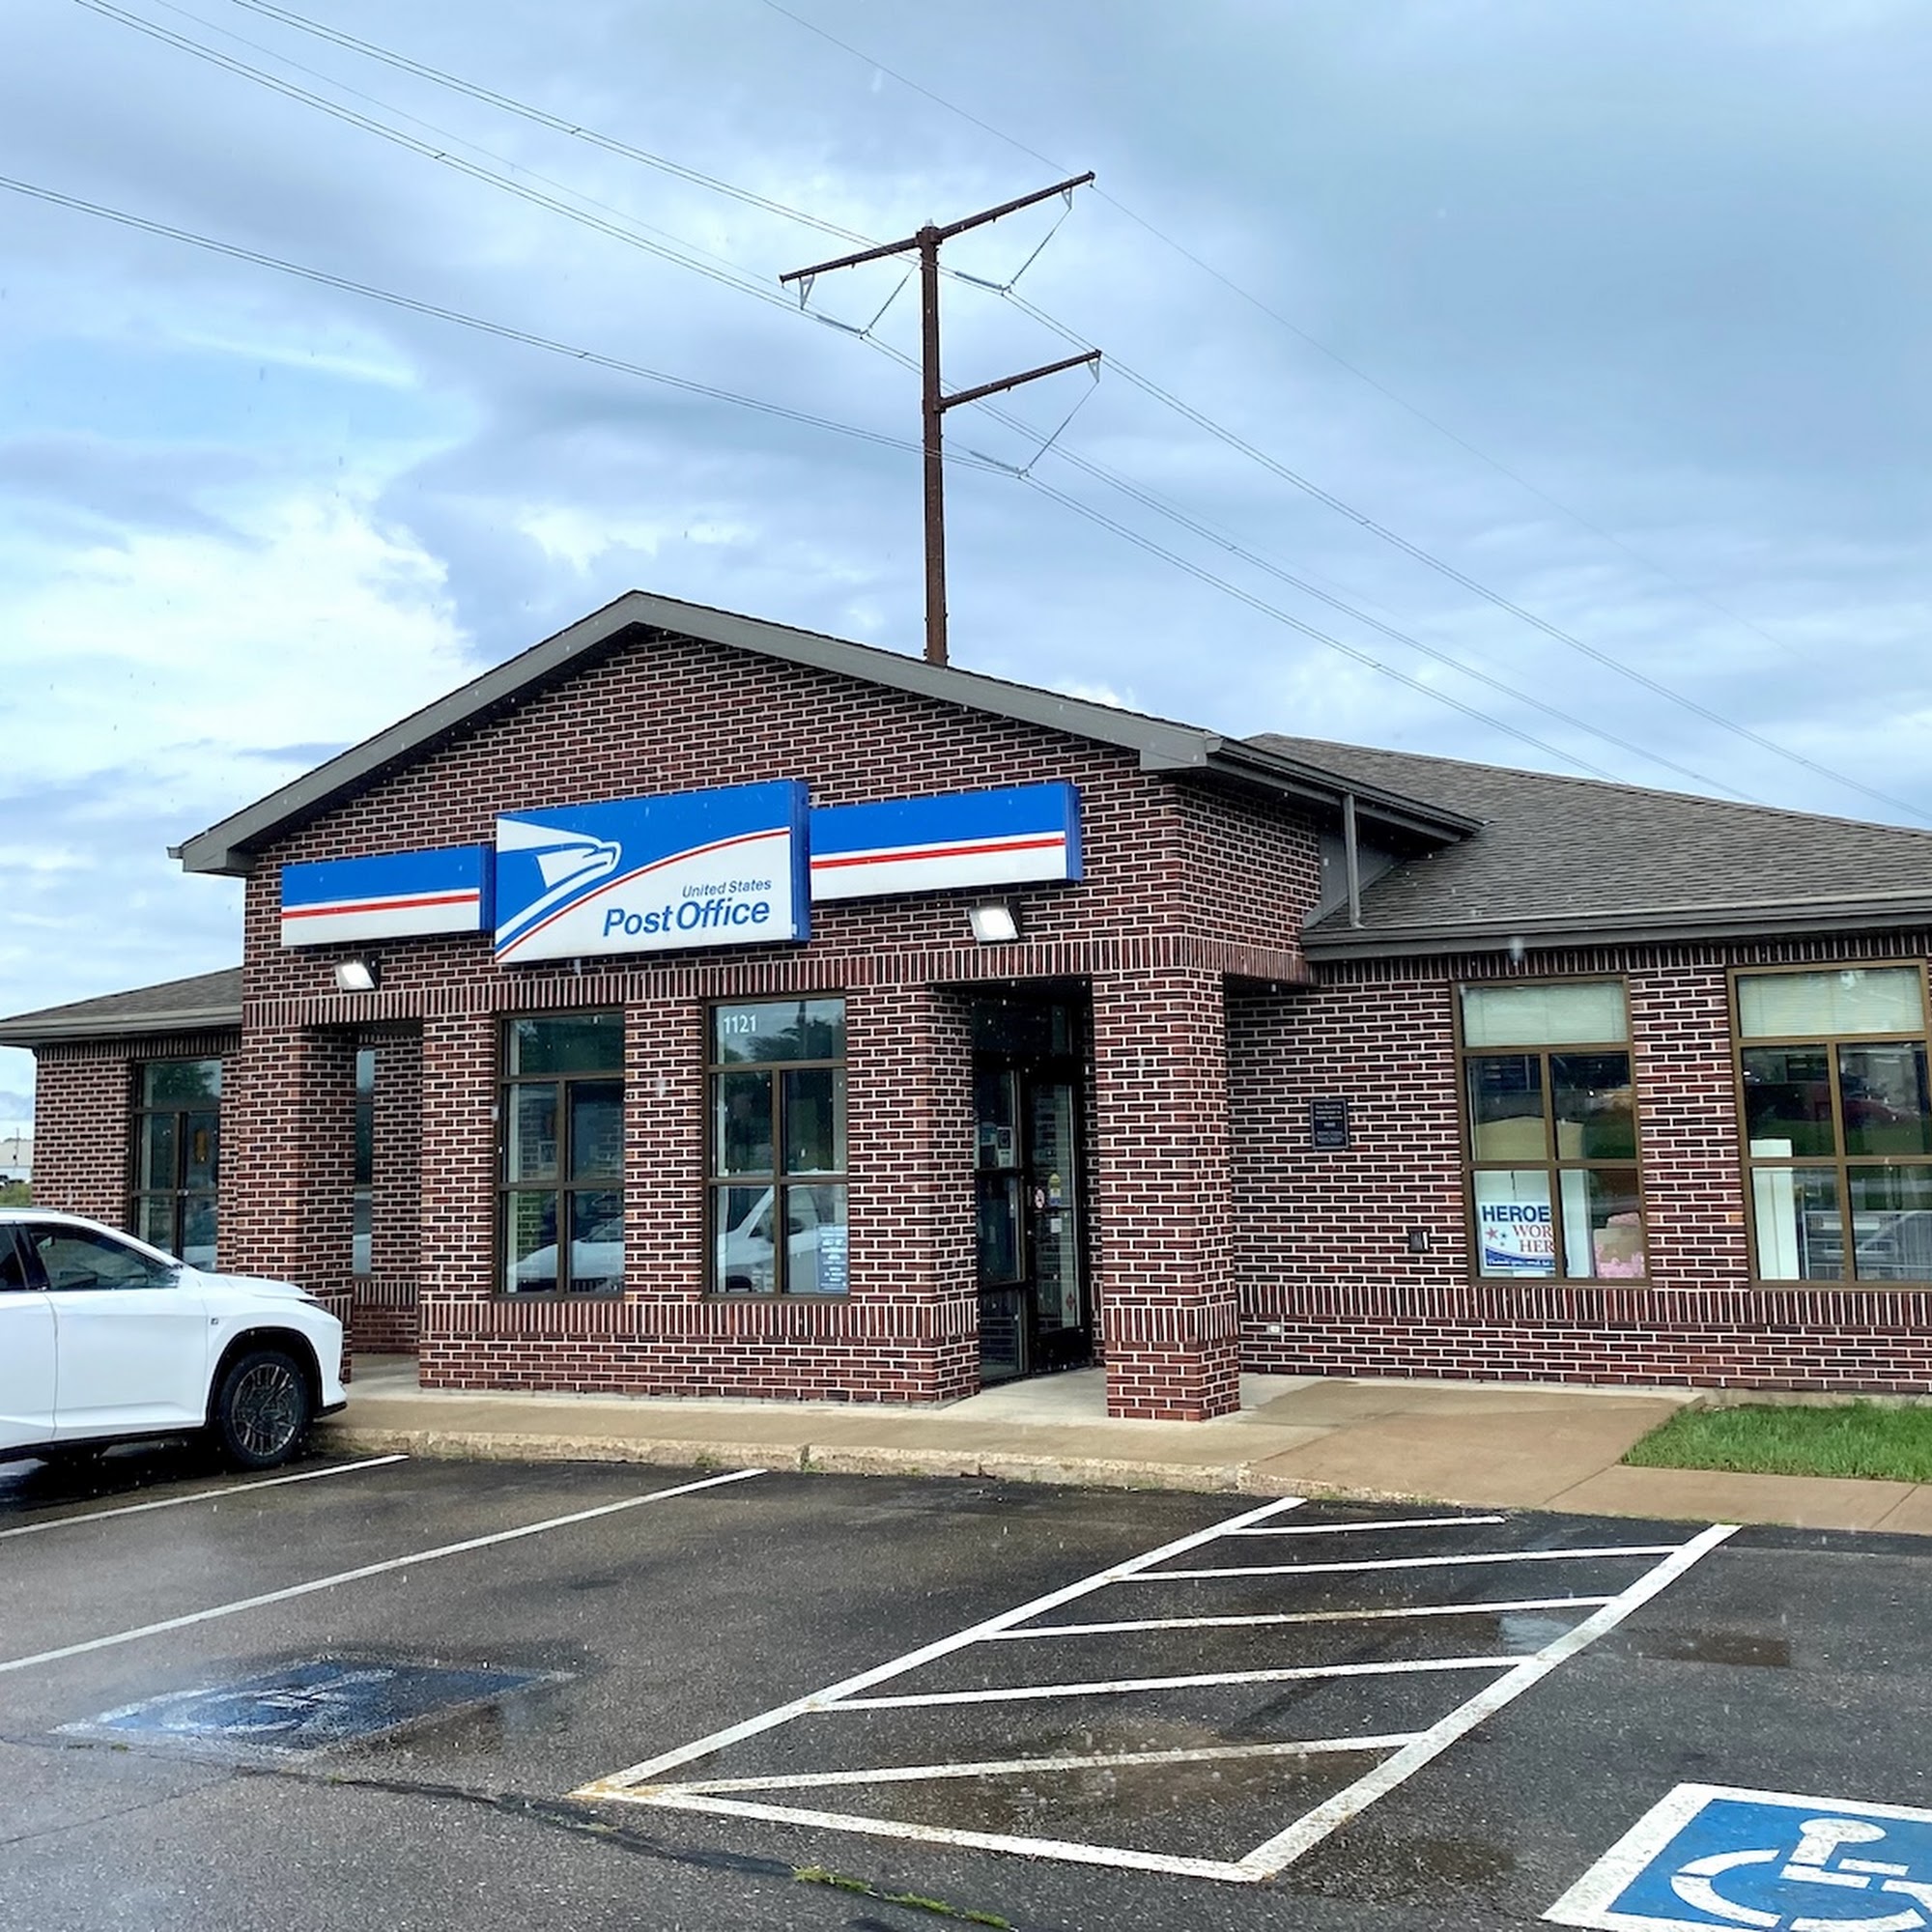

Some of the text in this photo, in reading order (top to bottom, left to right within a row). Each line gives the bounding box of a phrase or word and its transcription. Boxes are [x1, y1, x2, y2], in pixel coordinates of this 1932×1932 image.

[682, 879, 772, 898] United States
[603, 897, 771, 937] Post Office
[724, 1014, 756, 1035] 1121
[1482, 1205, 1550, 1223] HEROE
[1512, 1224, 1553, 1238] WOR
[1520, 1238, 1555, 1253] HER
